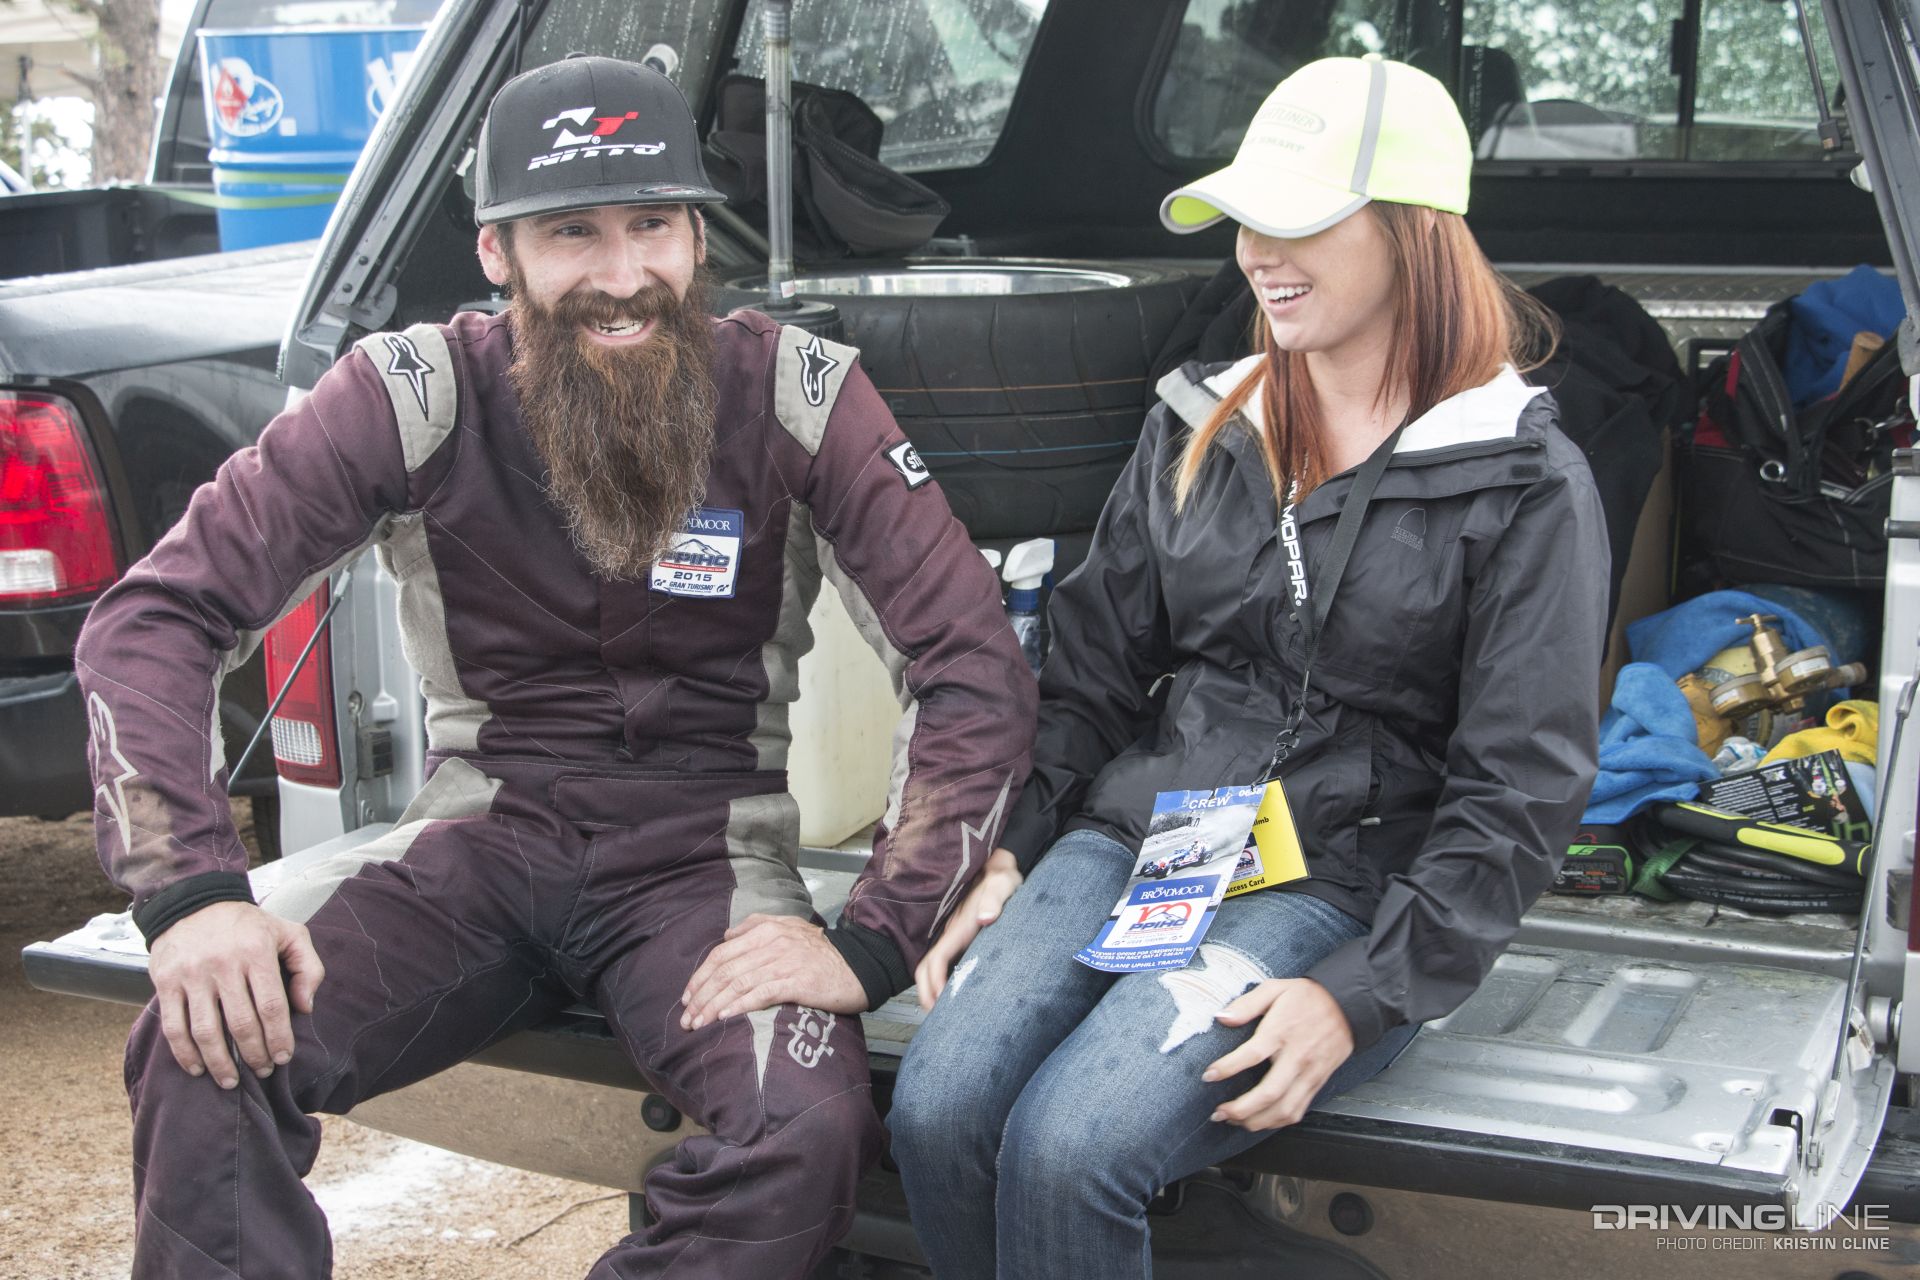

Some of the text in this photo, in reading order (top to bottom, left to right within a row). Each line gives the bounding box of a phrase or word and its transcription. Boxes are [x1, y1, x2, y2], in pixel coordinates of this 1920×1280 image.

[527, 143, 666, 171] NITTO
[686, 518, 731, 531] ADMOOR
[1281, 503, 1308, 601] MOPAR
[673, 571, 712, 582] 2015
[669, 581, 687, 589] GRAN
[687, 583, 714, 591] TURISMO
[1189, 796, 1231, 810] CREW
[1140, 884, 1205, 900] BROADMOOR
[1225, 877, 1266, 894] Access Card
[1077, 954, 1090, 962] NO
[1090, 960, 1109, 968] LEFT
[1157, 958, 1187, 966] TRAFFIC
